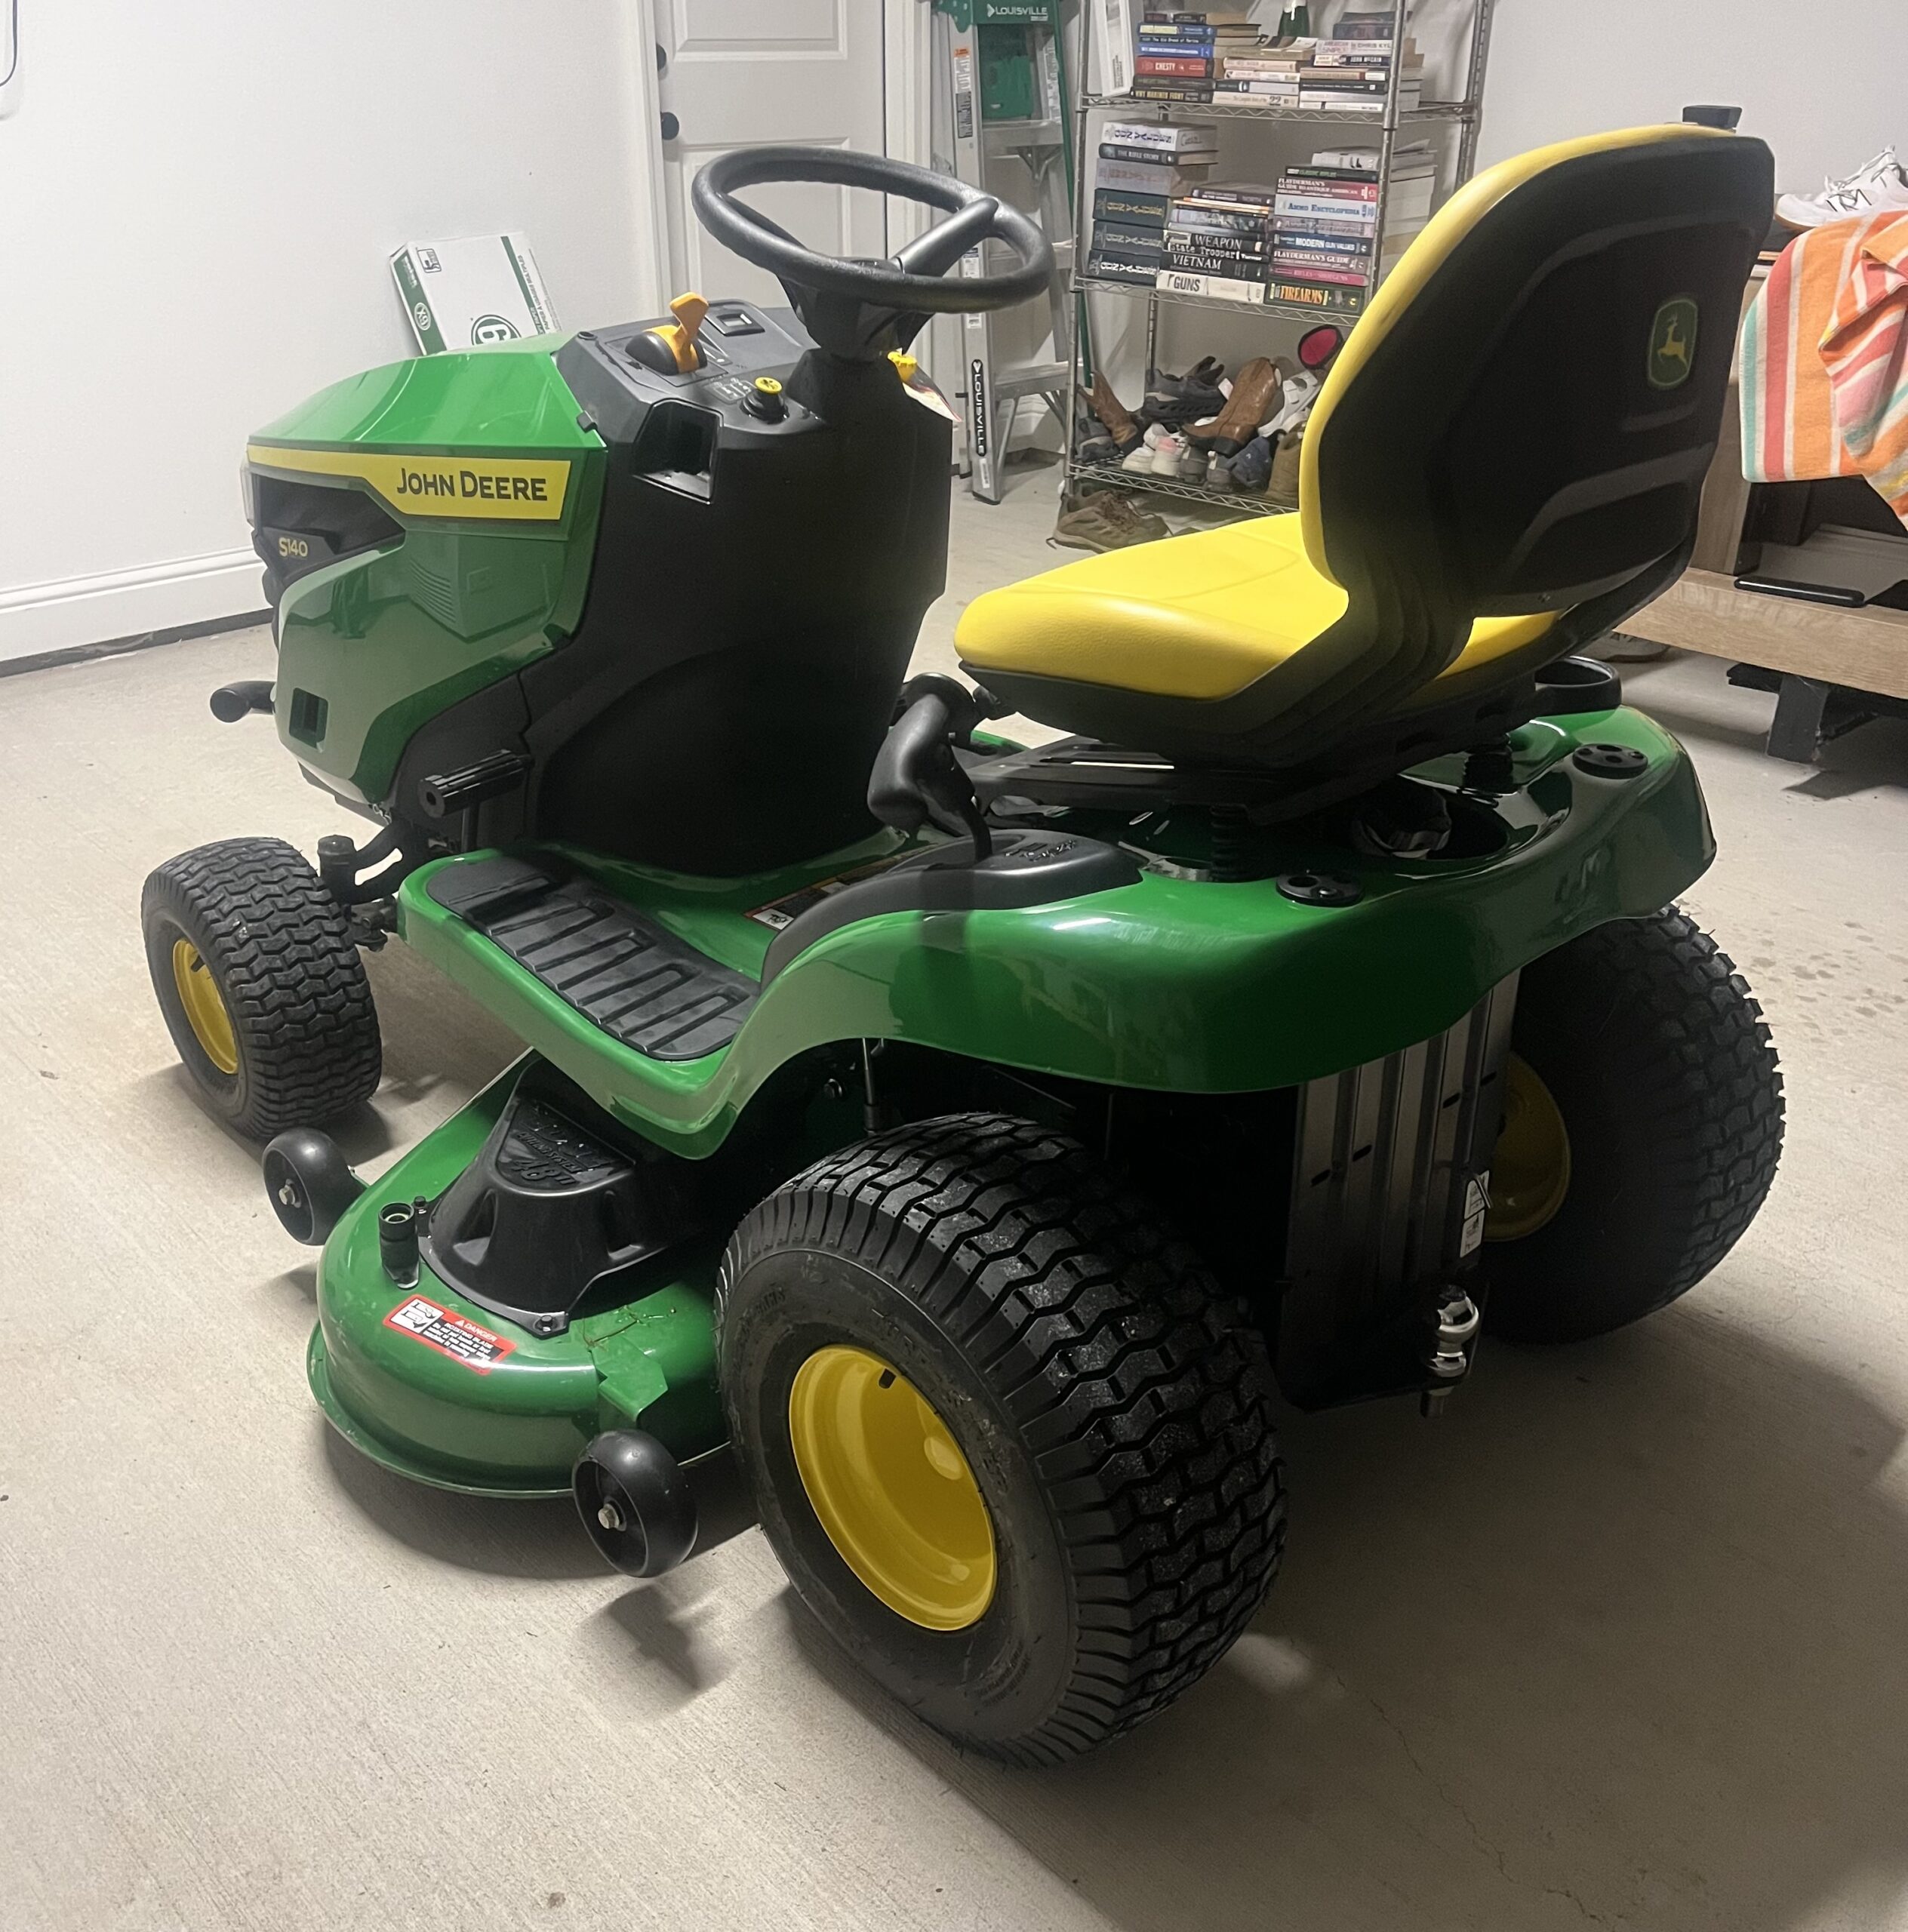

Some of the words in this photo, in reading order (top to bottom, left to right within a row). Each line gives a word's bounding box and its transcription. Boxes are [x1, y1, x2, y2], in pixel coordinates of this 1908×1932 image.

[996, 6, 1048, 14] LOUISVILLE
[1155, 62, 1176, 71] CHESTY
[1311, 204, 1360, 215] ENCYCLOPEDIA
[1170, 242, 1196, 254] State
[1200, 247, 1236, 260] Trooper
[1195, 234, 1243, 251] WEAPON
[1295, 237, 1325, 248] MODERN
[1172, 254, 1222, 270] VIETNAM
[1326, 255, 1350, 264] GUIDE
[1174, 275, 1201, 293] GUNS
[1280, 285, 1324, 305] FIREARMS
[974, 374, 984, 454] LOUISVILLE
[397, 468, 455, 497] JOHN
[459, 470, 548, 501] DEERE
[279, 537, 309, 558] S140
[444, 1322, 474, 1340] ROTATING
[471, 1336, 494, 1349] BLADE
[463, 1322, 498, 1343] DANGER
